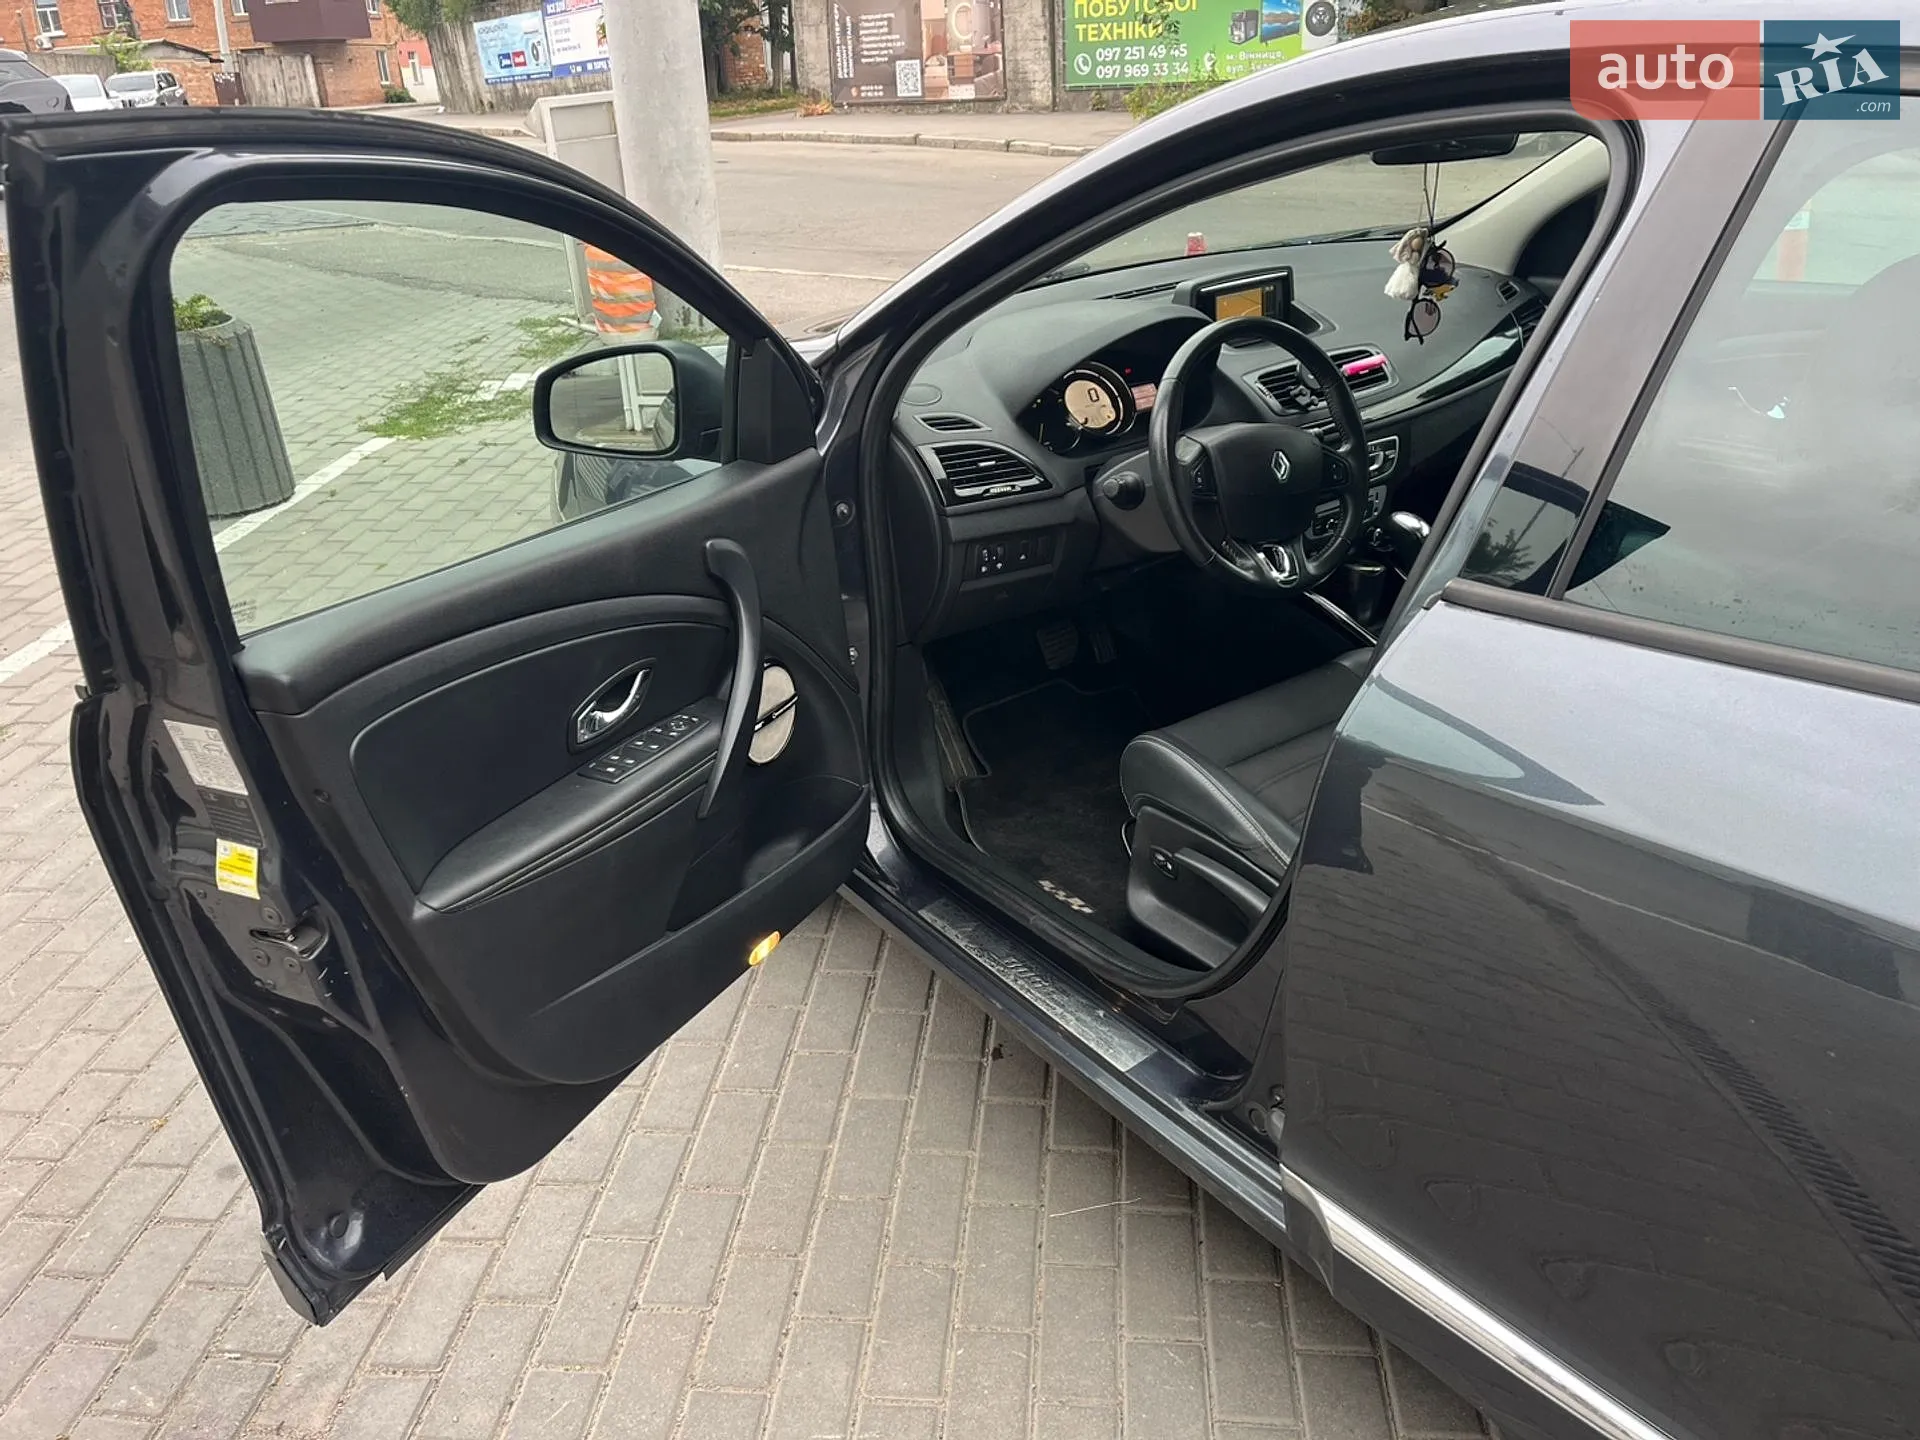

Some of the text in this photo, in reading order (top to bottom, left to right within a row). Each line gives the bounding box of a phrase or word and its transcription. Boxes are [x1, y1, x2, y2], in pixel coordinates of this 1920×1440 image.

[1075, 20, 1163, 42] ТЕХНІКИ
[1096, 44, 1187, 61] 097 251 49 45
[1096, 61, 1189, 79] 097 969 33 34
[1088, 387, 1099, 402] 0
